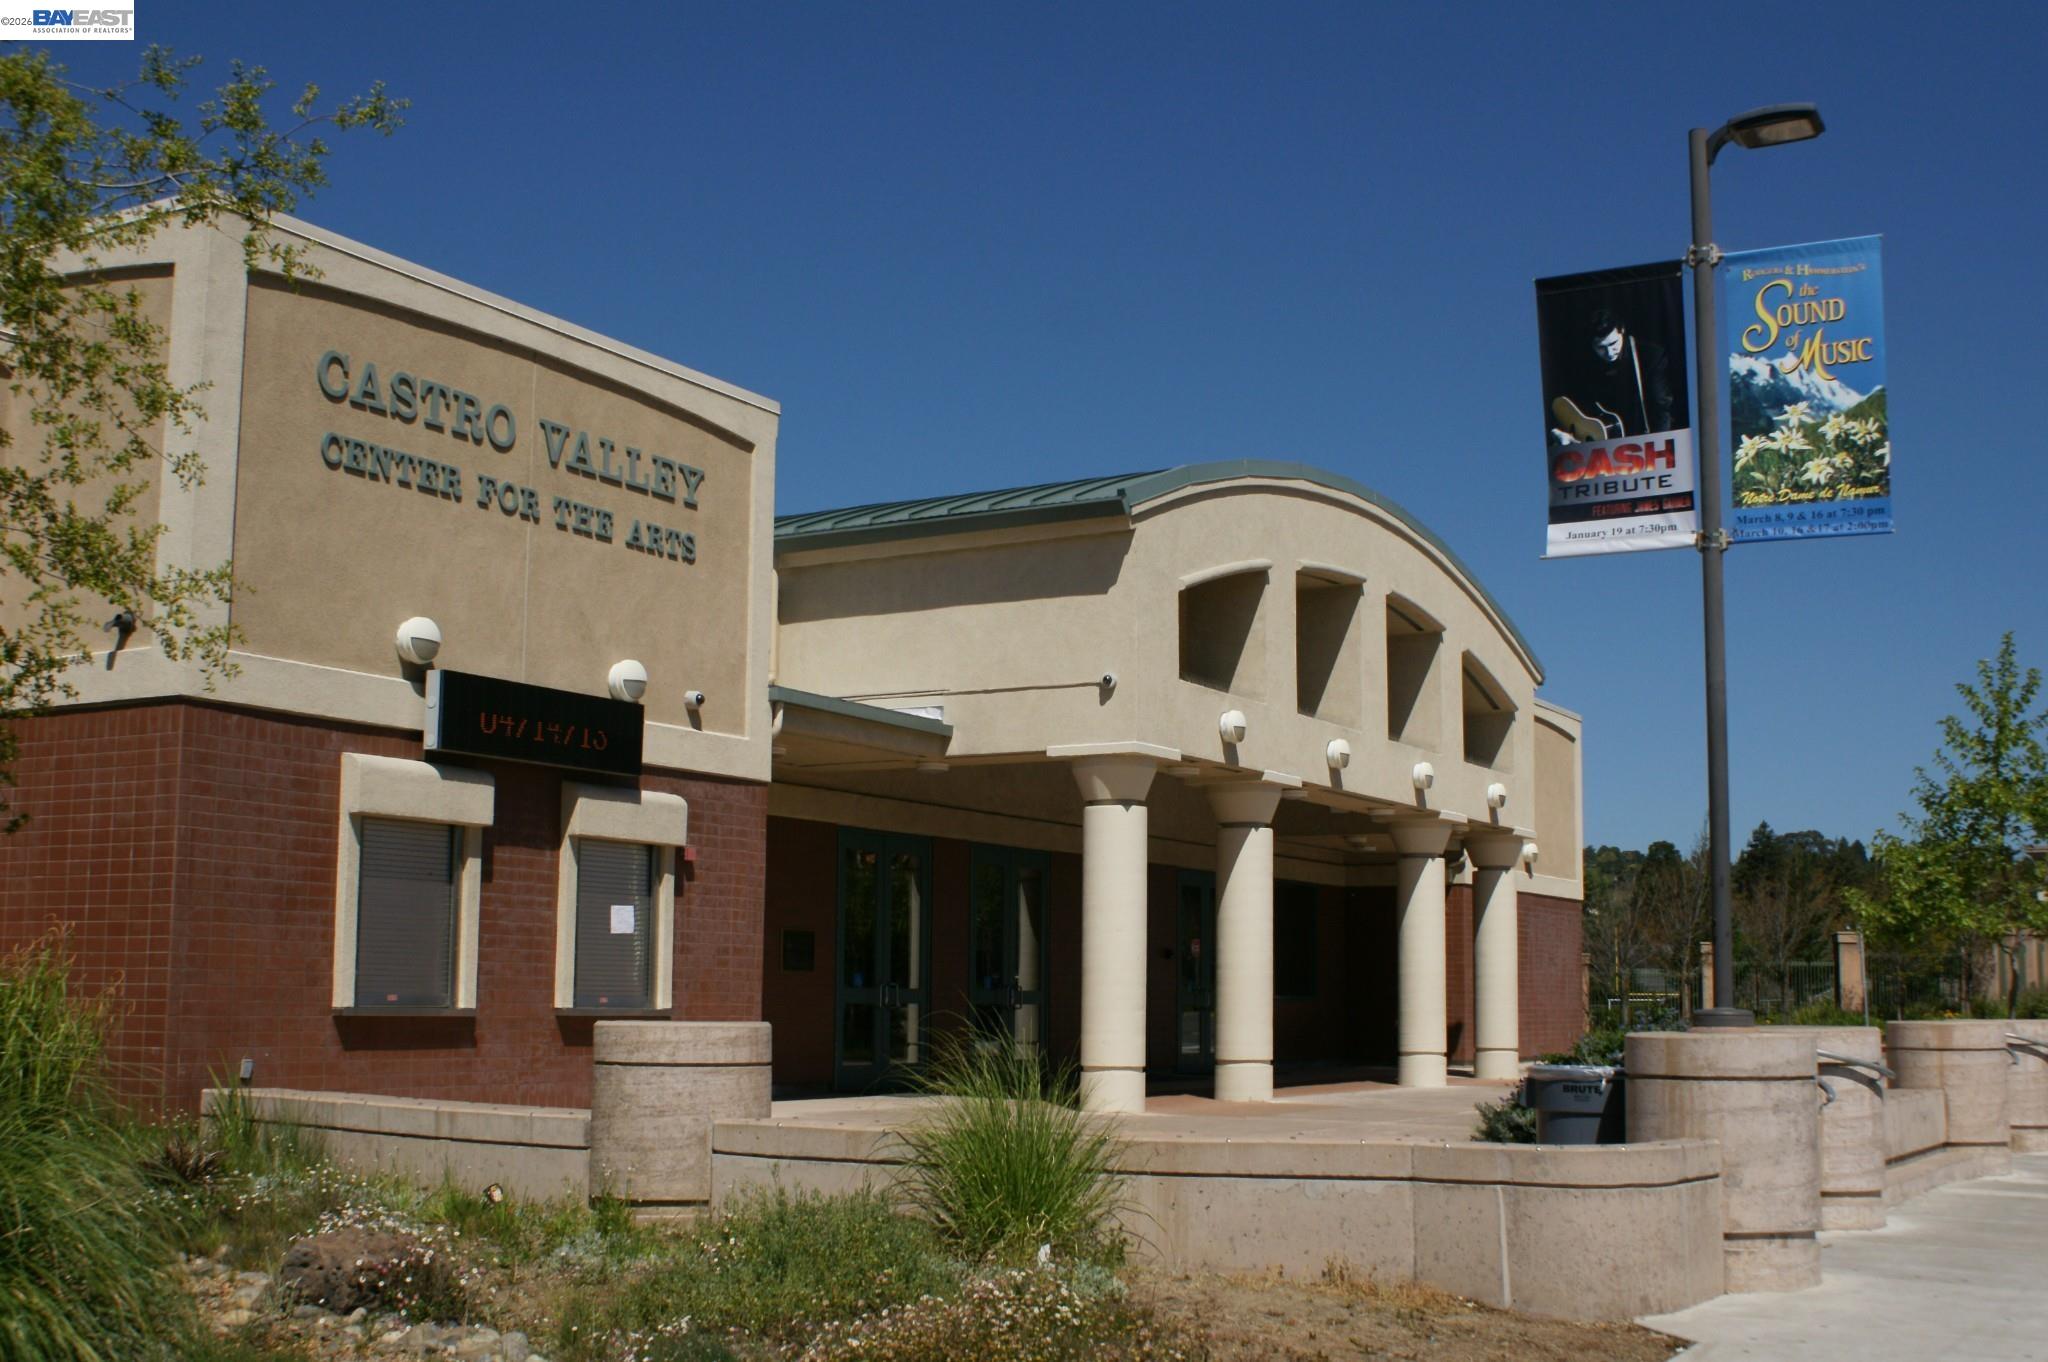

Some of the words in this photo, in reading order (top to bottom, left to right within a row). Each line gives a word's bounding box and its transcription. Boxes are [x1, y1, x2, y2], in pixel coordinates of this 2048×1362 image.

[1799, 283, 1818, 296] the
[1742, 279, 1846, 353] SOUND
[1785, 329, 1802, 351] of
[1780, 327, 1873, 381] MUSIC
[317, 350, 516, 453] CASTRO
[539, 417, 704, 511] VALLEY
[1554, 438, 1676, 483] CASH
[321, 431, 462, 503] CENTER
[477, 474, 540, 525] FOR
[553, 496, 614, 544] THE
[625, 519, 697, 565] ARTS
[1558, 474, 1673, 500] TRIBUTE
[1741, 490, 1776, 504] Notre
[1778, 487, 1816, 502] Dame
[1818, 486, 1834, 498] de
[1736, 513, 1772, 525] March
[1787, 511, 1795, 520] 9
[1796, 511, 1807, 521] &
[1811, 510, 1824, 520] 16
[1826, 509, 1837, 518] at
[1841, 506, 1864, 517] 7:30
[1867, 507, 1886, 518] pm
[1565, 530, 1607, 540] January
[1611, 526, 1623, 536] 19
[1625, 527, 1635, 535] at
[1639, 523, 1678, 535] 7:30pm
[1731, 527, 1768, 538] March
[1832, 522, 1844, 532] at
[1562, 1084, 1601, 1094] BRUTE
